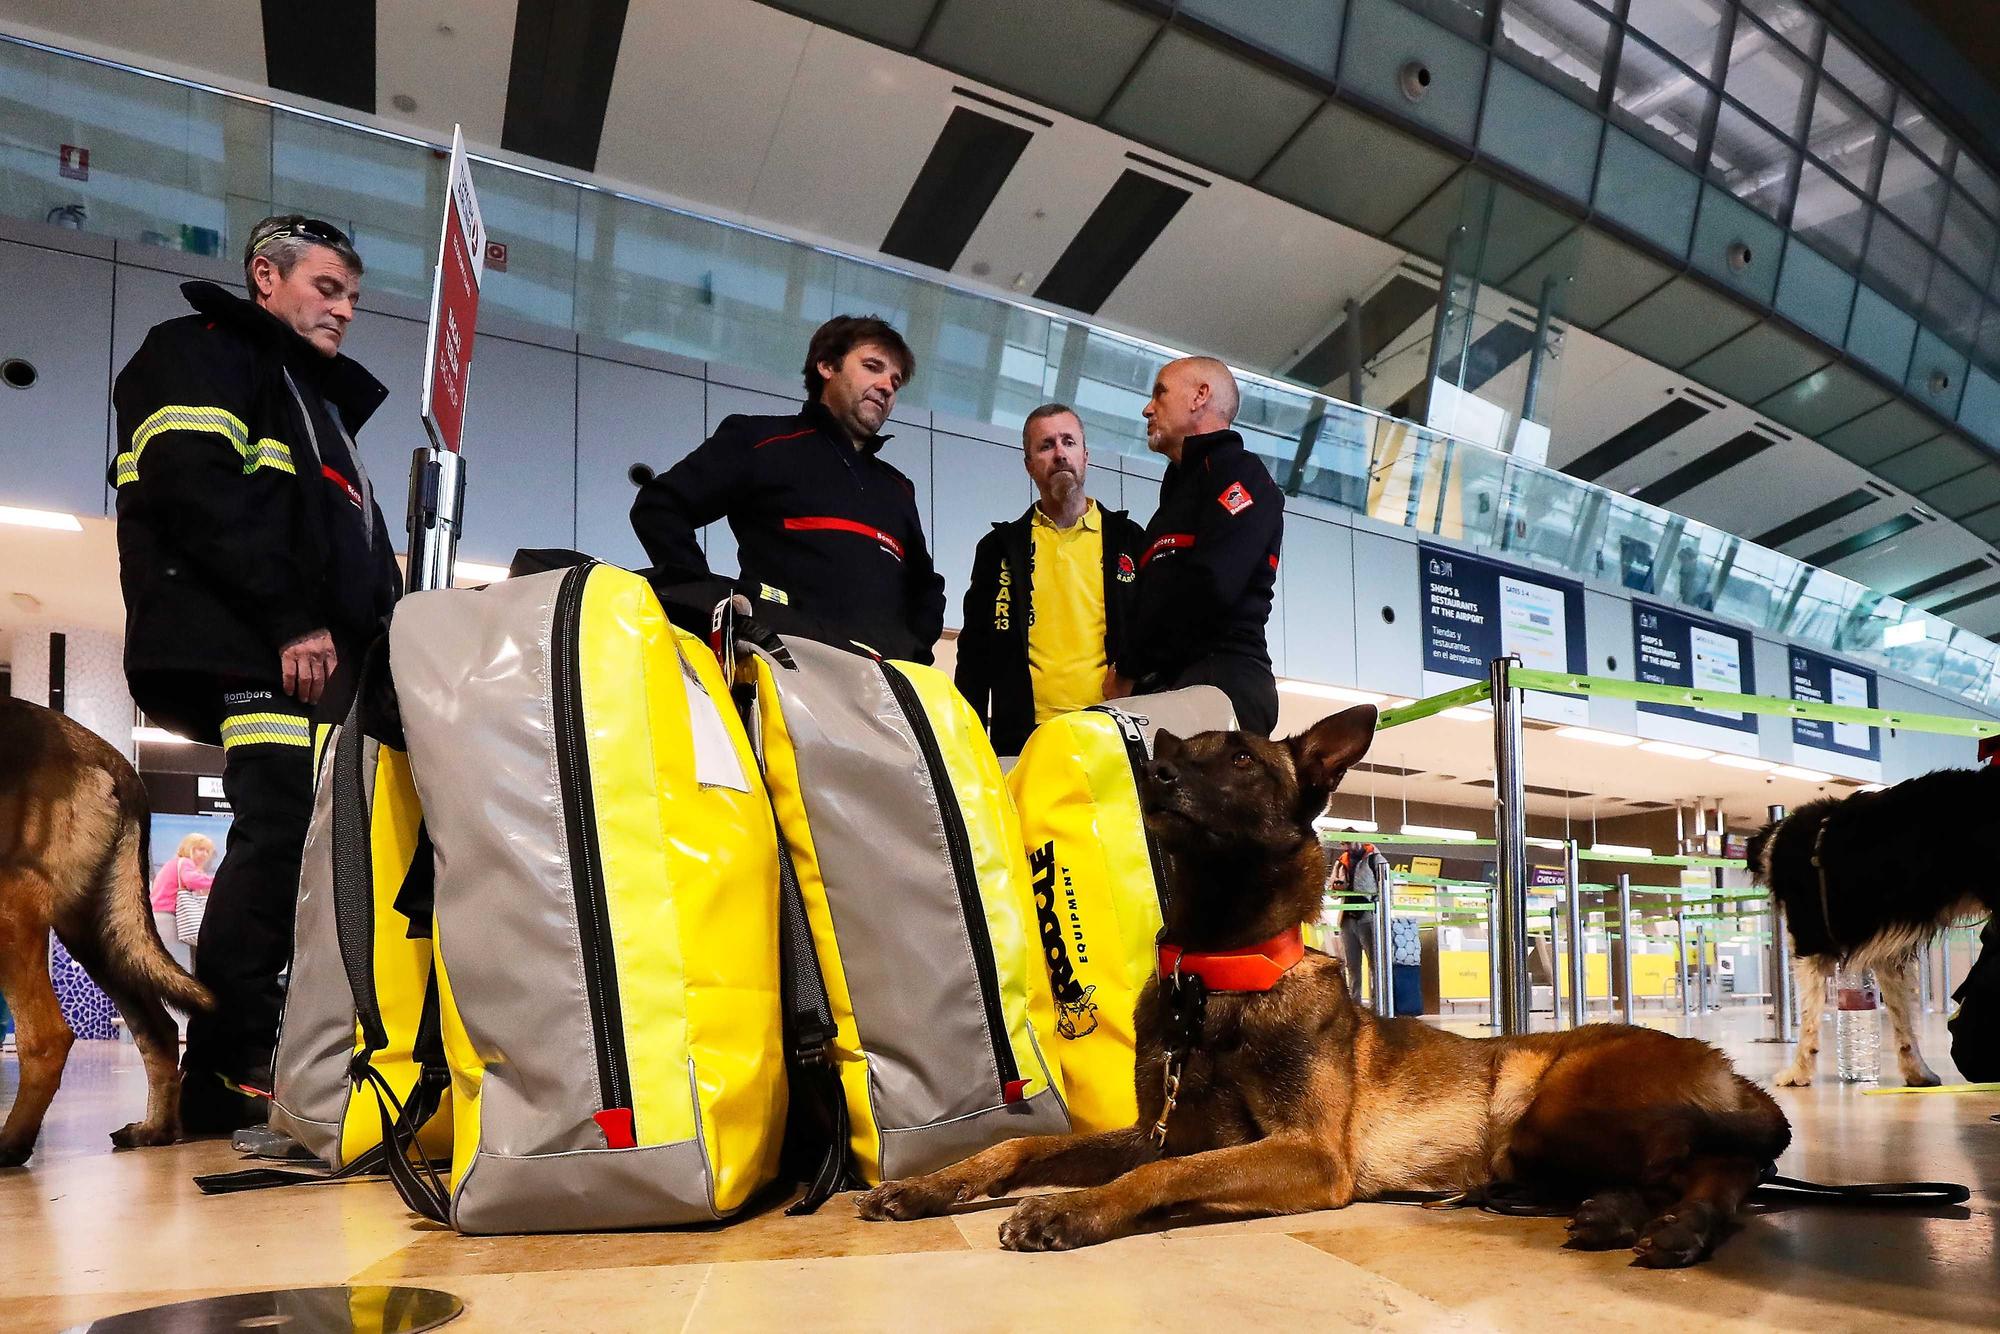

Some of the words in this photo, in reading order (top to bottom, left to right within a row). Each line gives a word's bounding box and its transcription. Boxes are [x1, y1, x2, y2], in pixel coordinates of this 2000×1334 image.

[1430, 583, 1454, 595] SHOPS
[1454, 588, 1460, 597] &
[1431, 594, 1478, 612] RESTAURANTS
[1431, 605, 1441, 616] AT
[1441, 607, 1455, 619] THE
[1455, 611, 1484, 625] AIRPORT
[1432, 626, 1456, 639] Tiendas
[1456, 631, 1462, 641] y
[1433, 638, 1471, 653] restaurantes
[1433, 651, 1442, 659] en
[1442, 649, 1449, 660] el
[1449, 653, 1483, 667] aeropuerto
[223, 690, 273, 703] Bombers
[1061, 866, 1089, 963] EQUIPMENT
